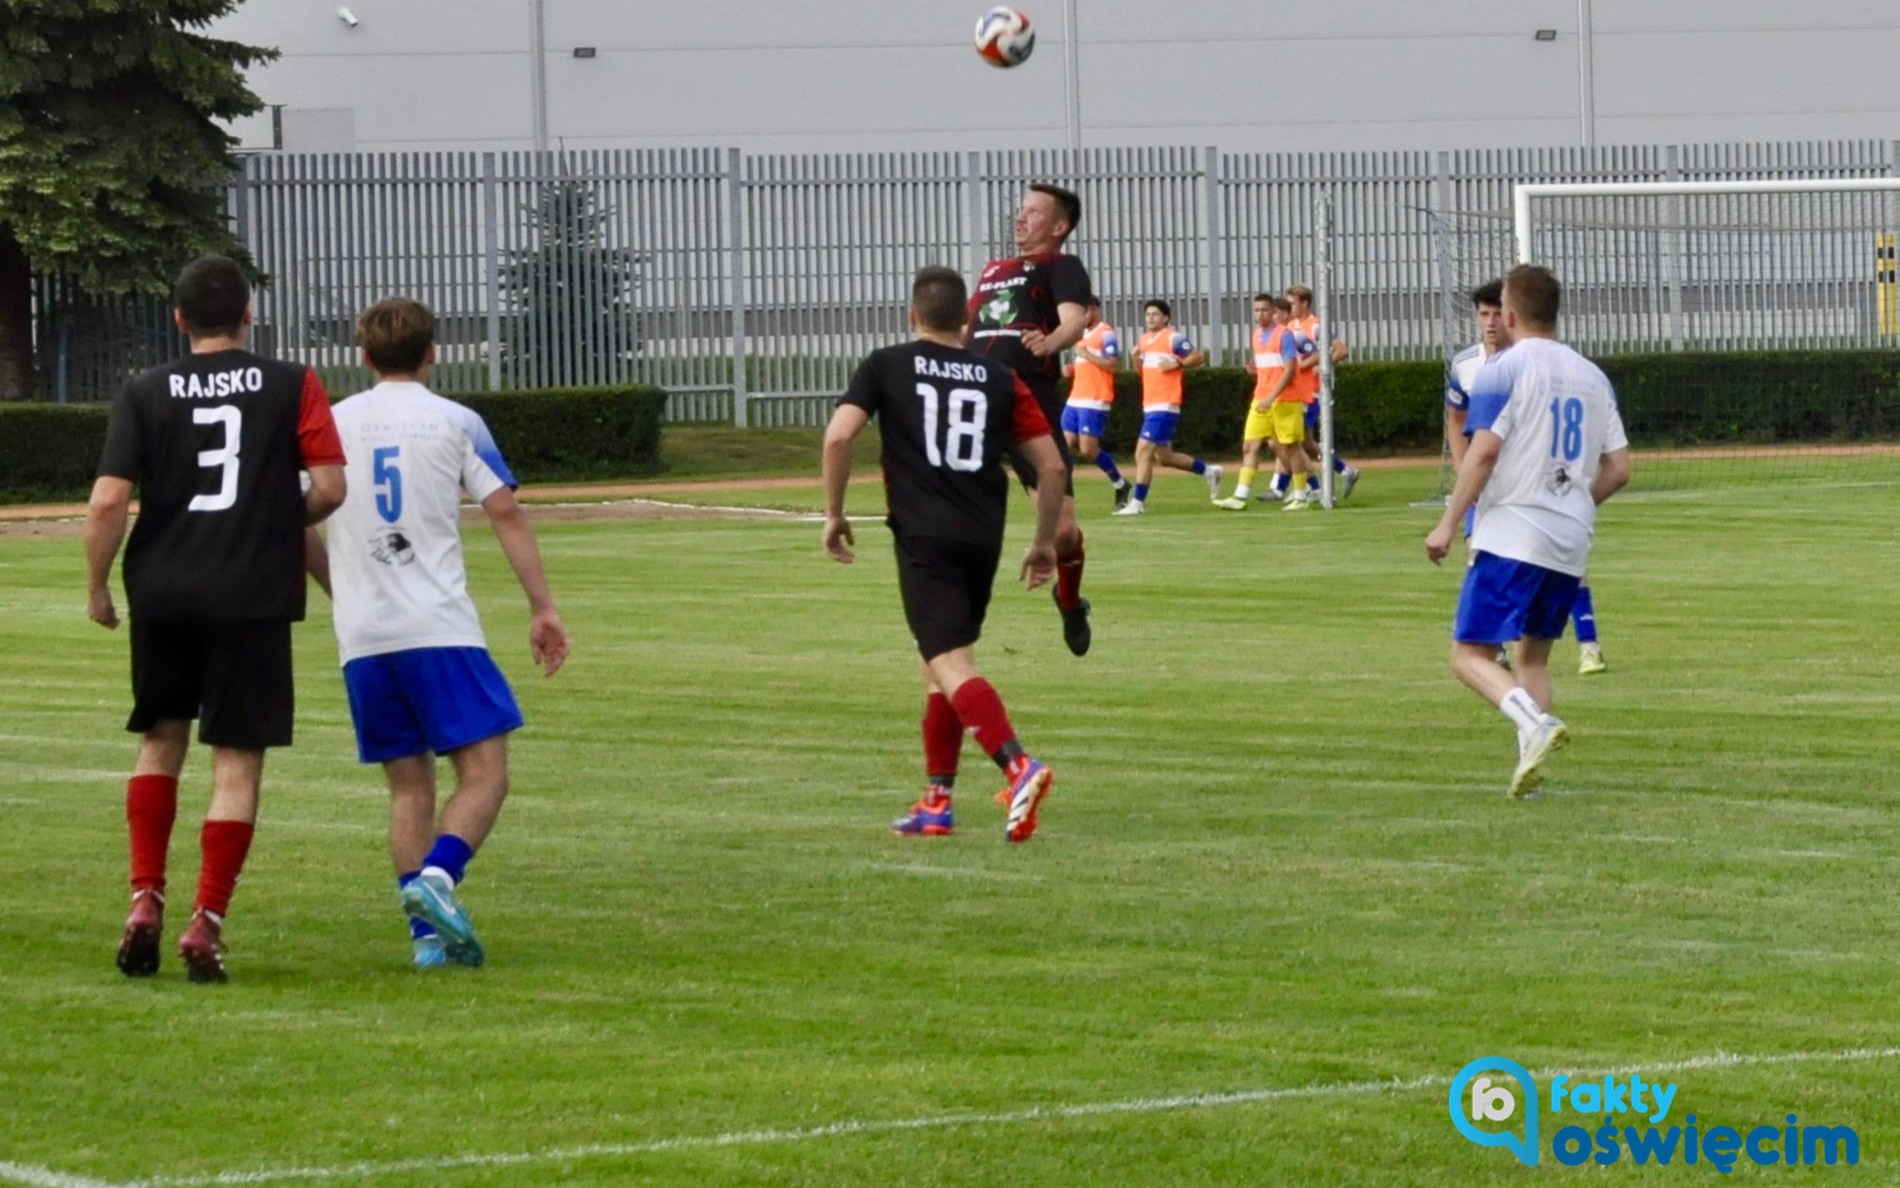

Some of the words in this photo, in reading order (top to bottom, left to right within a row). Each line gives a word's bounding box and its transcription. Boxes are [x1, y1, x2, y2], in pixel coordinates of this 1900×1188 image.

[168, 366, 263, 398] RAJSKO
[914, 356, 987, 384] RAJSKO
[187, 404, 242, 512] 3
[915, 382, 988, 472] 18
[1550, 396, 1584, 462] 18
[373, 446, 402, 523] 5
